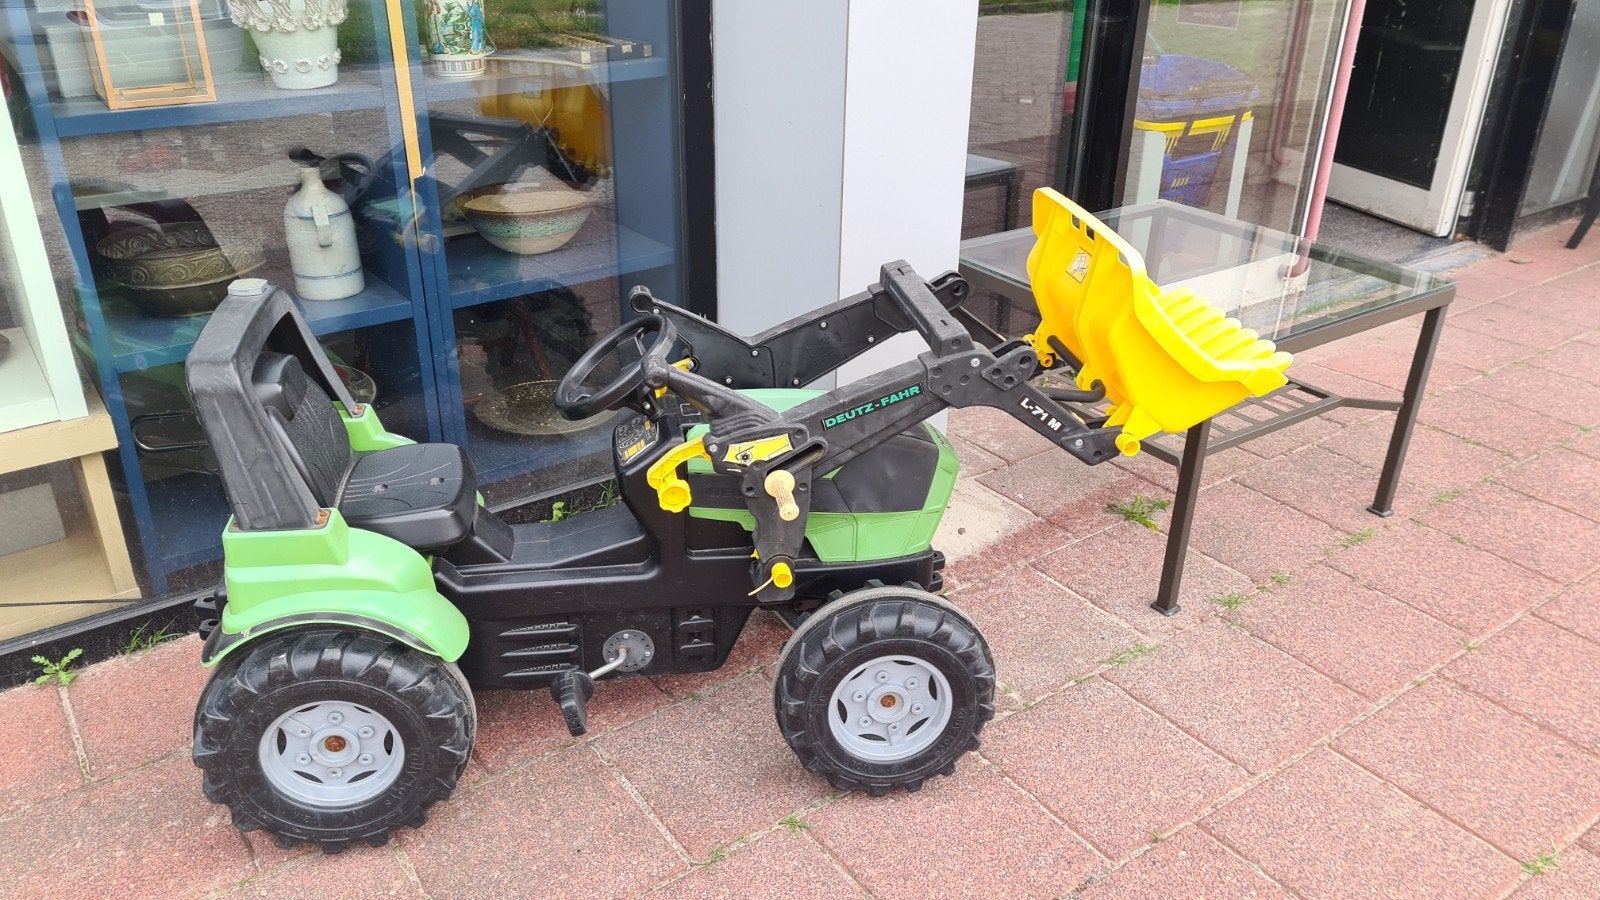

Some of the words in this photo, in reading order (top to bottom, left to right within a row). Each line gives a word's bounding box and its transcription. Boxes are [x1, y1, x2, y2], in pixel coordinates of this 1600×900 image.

[824, 385, 920, 428] DEUTZ-FAHR
[1020, 397, 1049, 422] L-71
[1047, 417, 1062, 431] M
